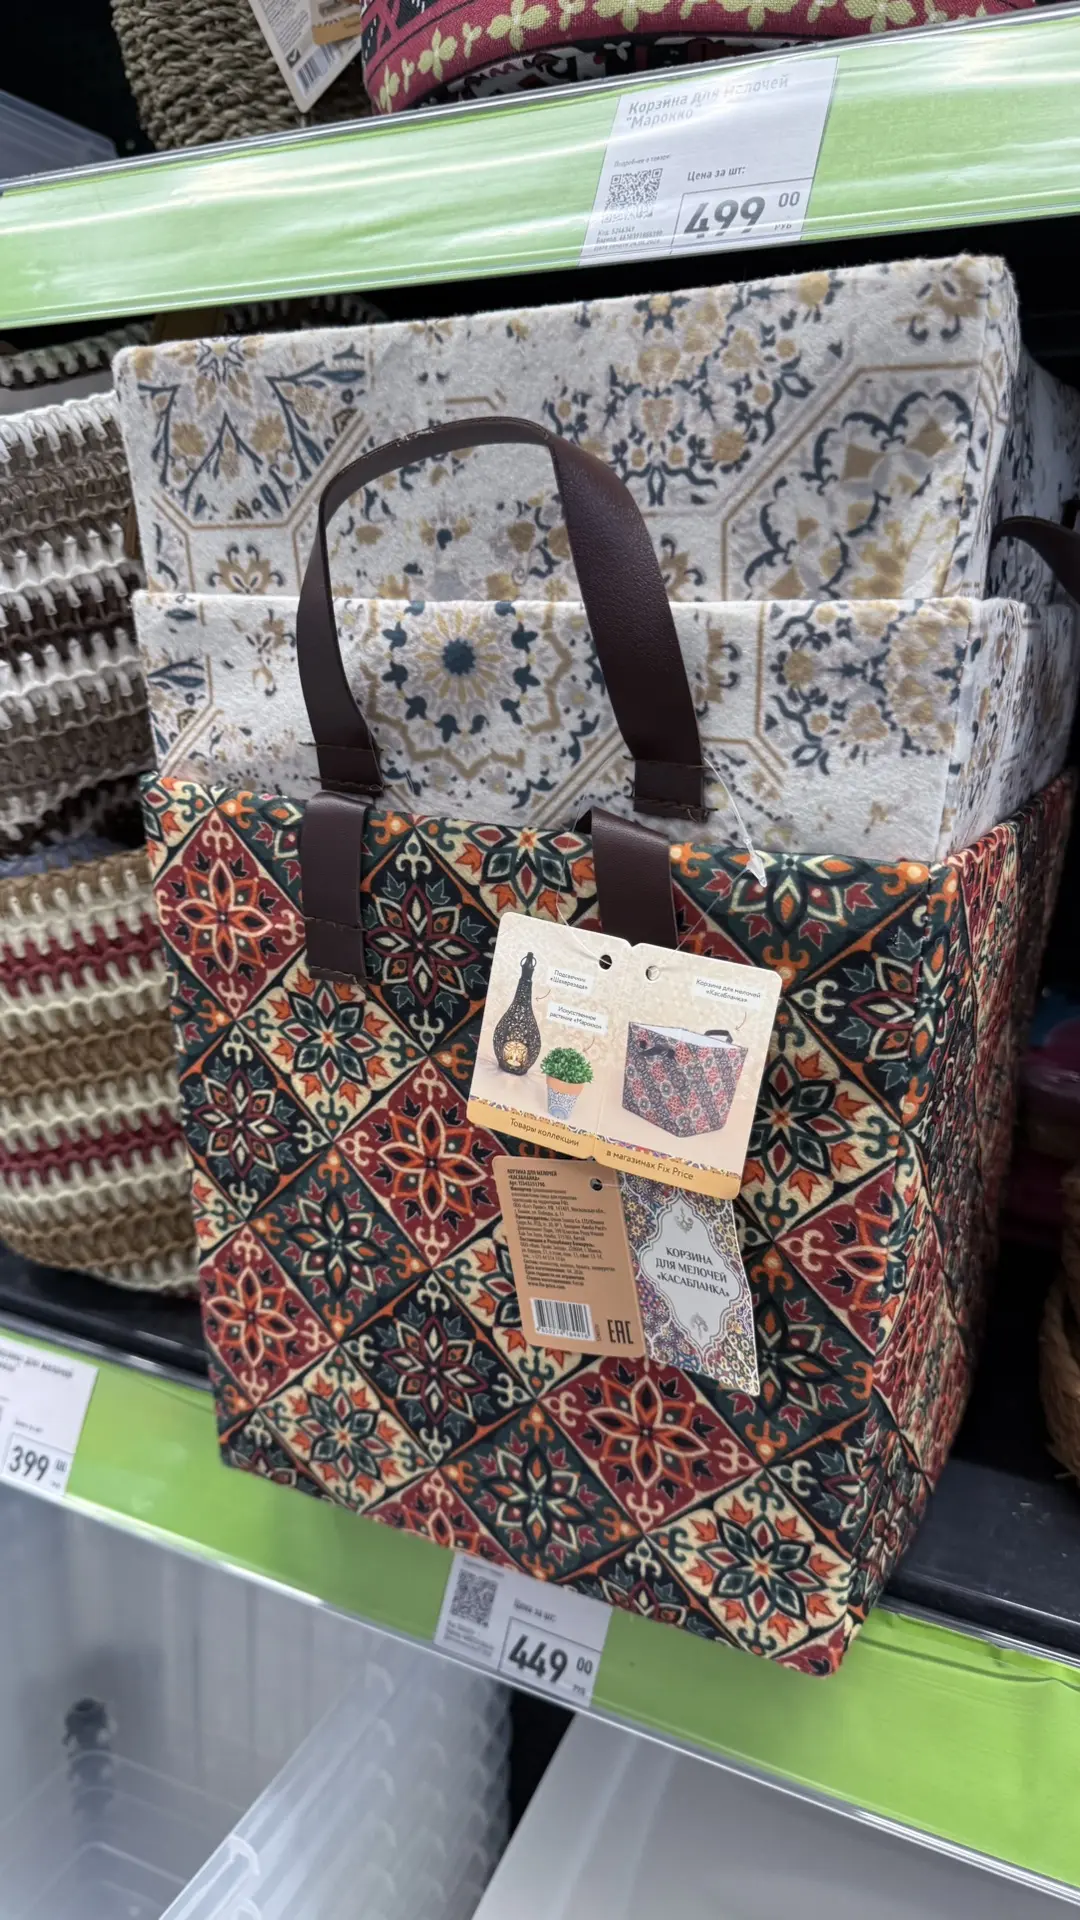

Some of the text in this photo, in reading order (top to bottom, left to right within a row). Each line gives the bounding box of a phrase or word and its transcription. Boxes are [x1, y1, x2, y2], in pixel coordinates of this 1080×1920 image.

[628, 95, 687, 115] Корзина
[690, 88, 721, 106] для
[687, 166, 746, 182] Цена за шт:
[684, 191, 801, 239] 499 00
[696, 978, 722, 989] Корзина
[734, 988, 761, 998] мелочей
[706, 990, 748, 1003] «Касабланка»
[549, 1012, 573, 1022] растение
[510, 1118, 580, 1147] Товары коллекции
[612, 1152, 655, 1170] магазинах
[657, 1162, 671, 1174] Fix
[671, 1166, 694, 1181] Price
[666, 1247, 713, 1266] КОРЗИНА
[655, 1257, 727, 1283] ДЛЯ МЕЛОЧЕЙ
[657, 1271, 730, 1297] «КАСАБЛАНКА»
[607, 1319, 634, 1344] EAC
[9, 1445, 49, 1482] 399
[508, 1633, 568, 1683] 449
[576, 1656, 593, 1675] 00
